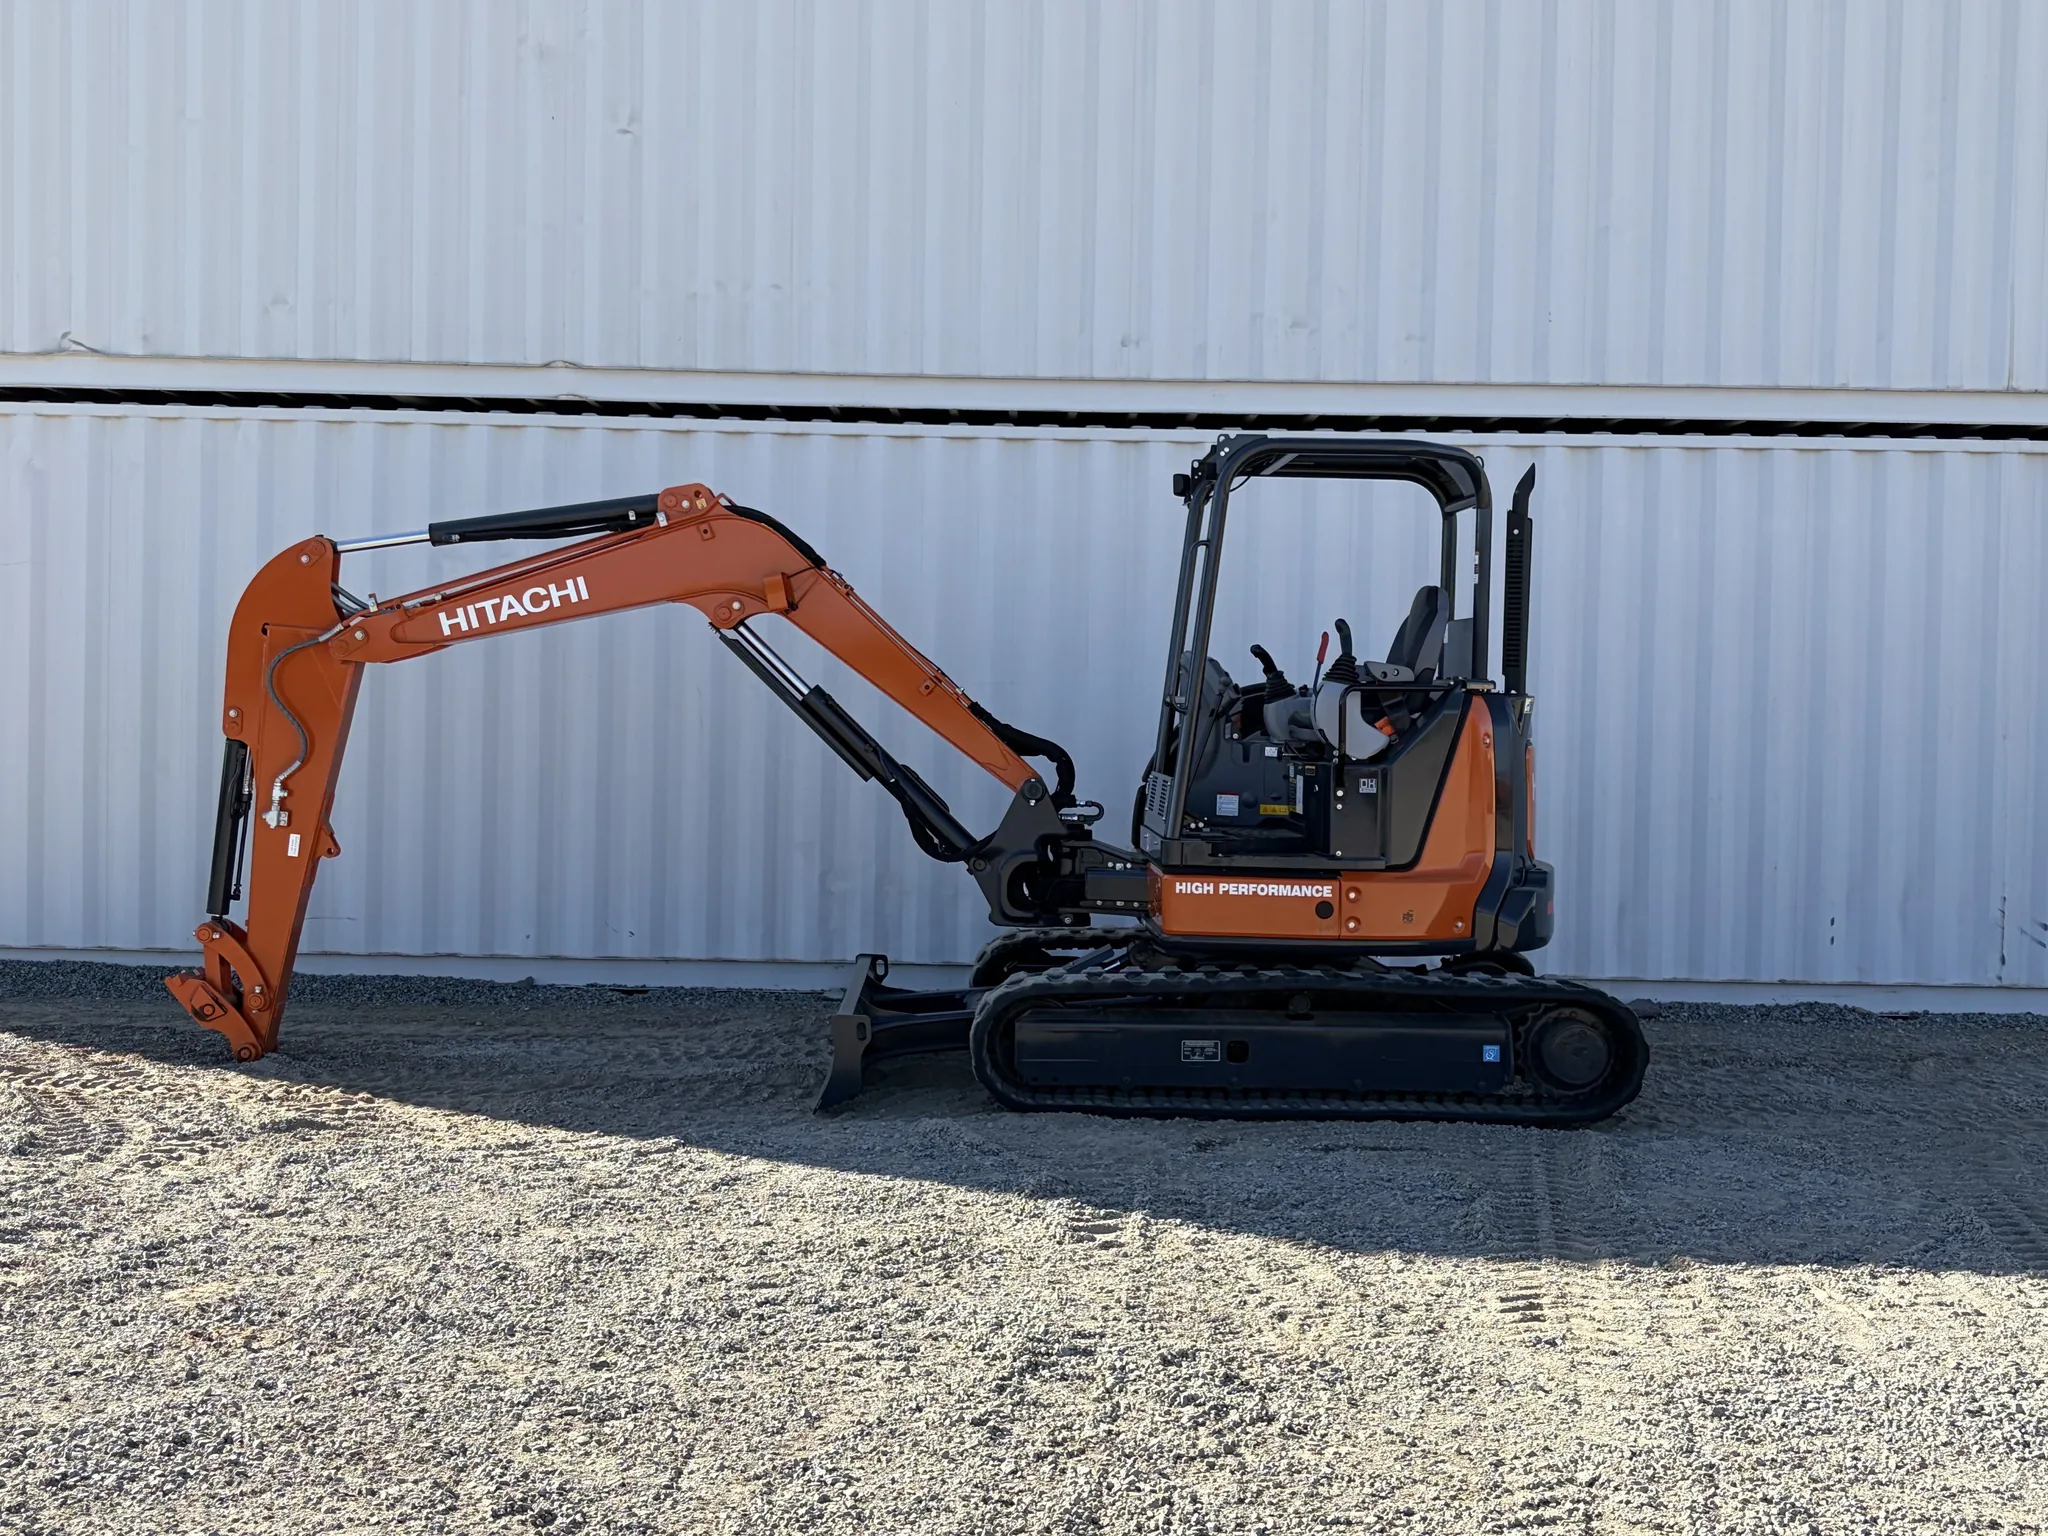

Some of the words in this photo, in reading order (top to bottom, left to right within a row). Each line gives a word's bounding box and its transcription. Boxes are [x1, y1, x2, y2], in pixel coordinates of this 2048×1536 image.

[438, 576, 590, 636] HITACHI
[1175, 882, 1214, 895] HIGH
[1219, 883, 1332, 898] PERFORMANCE
